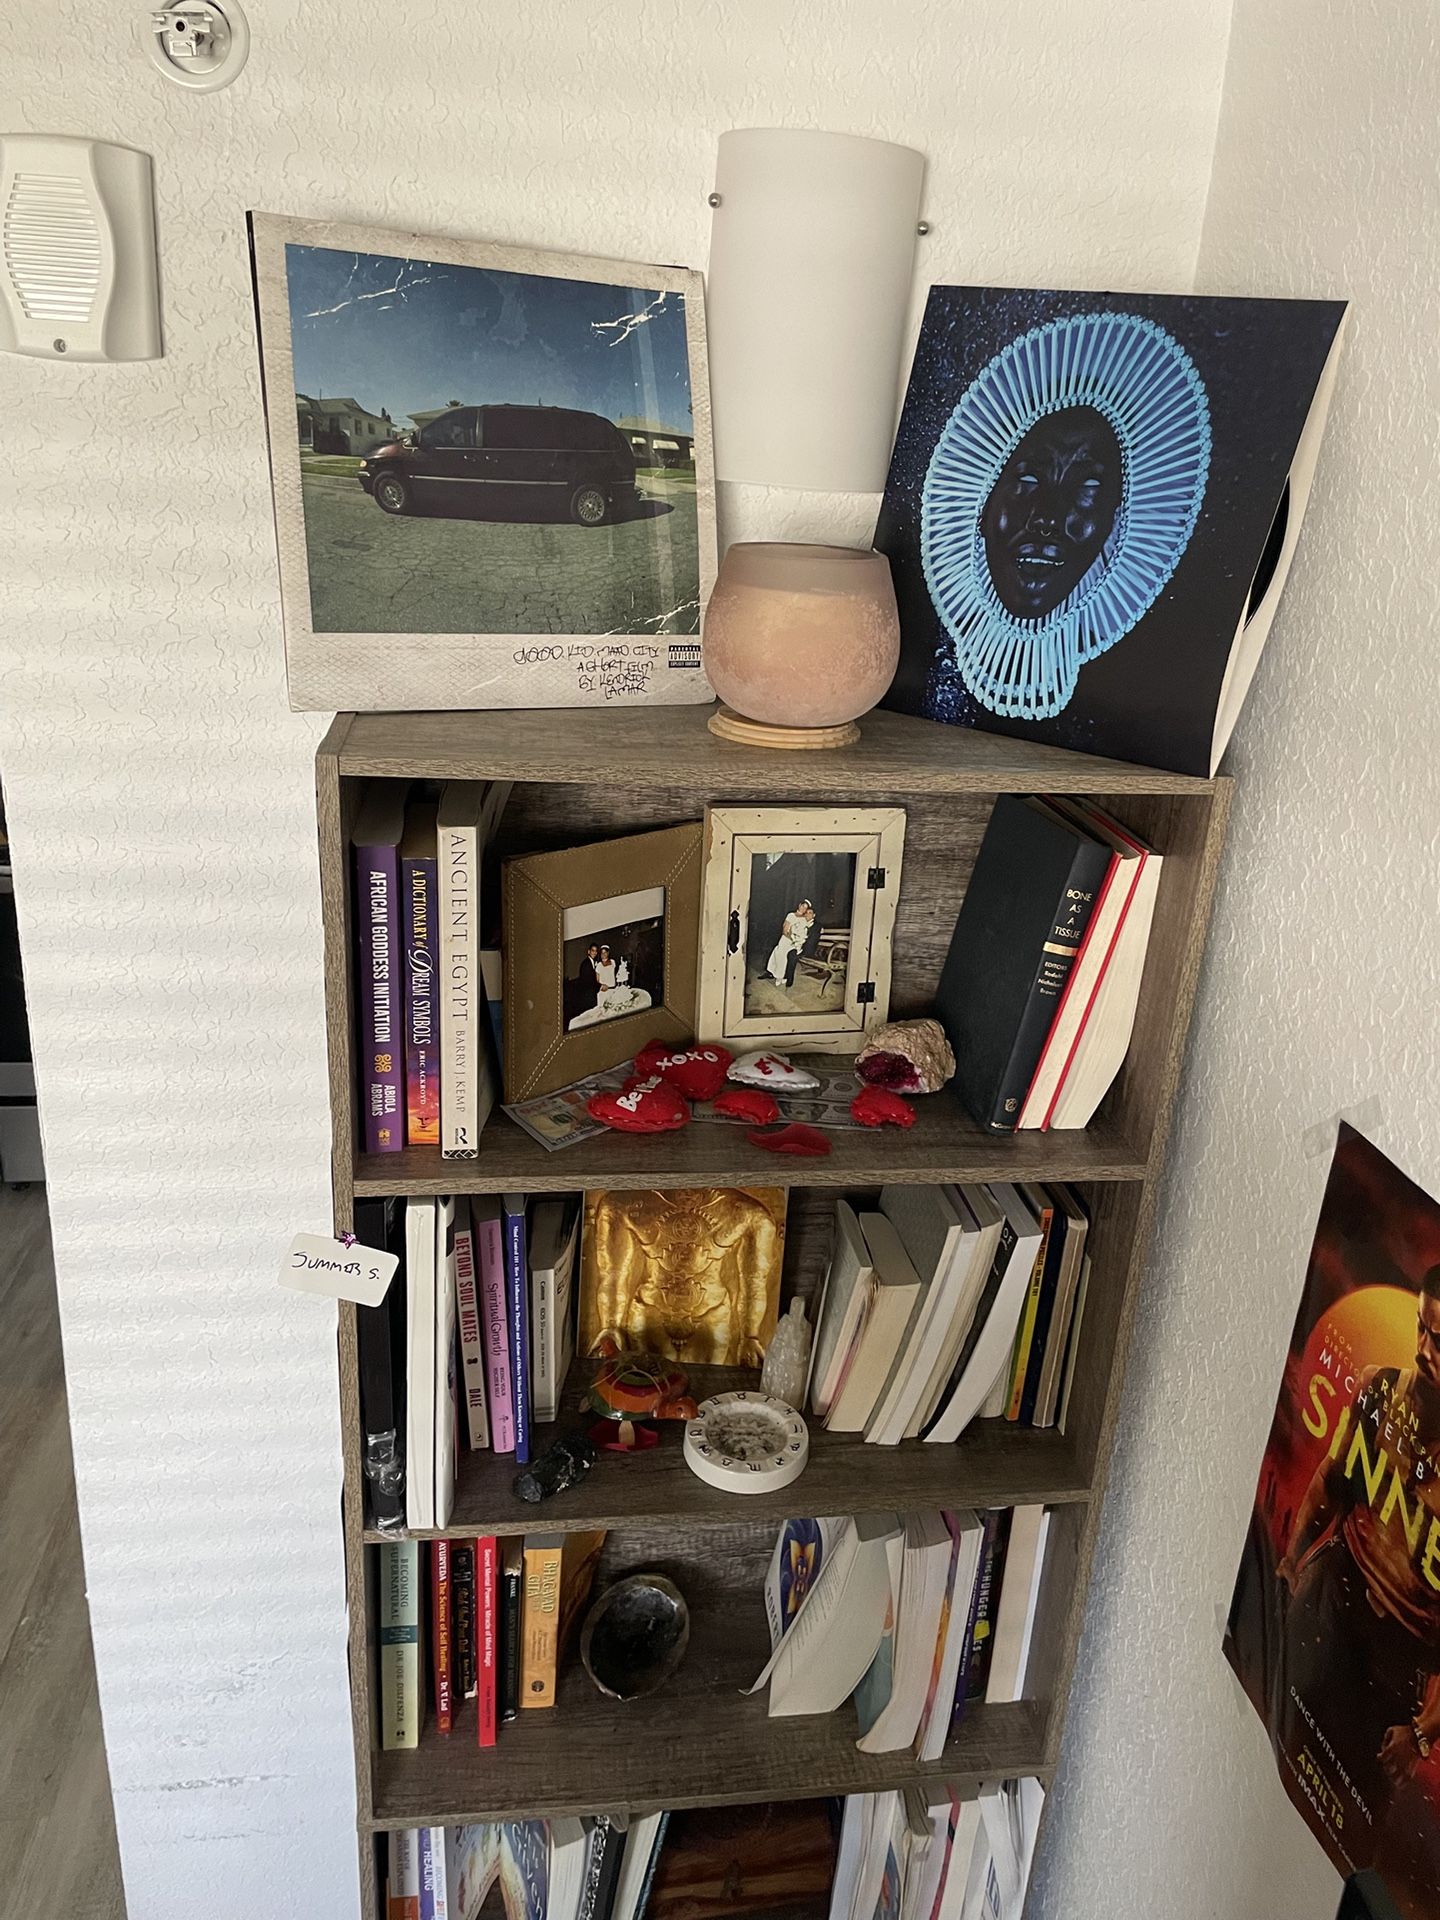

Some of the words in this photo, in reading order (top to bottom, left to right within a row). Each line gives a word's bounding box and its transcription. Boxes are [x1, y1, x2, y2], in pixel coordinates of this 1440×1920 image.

[605, 681, 648, 699] LAMAR
[412, 869, 426, 877] A
[450, 834, 468, 942] ANCIENT
[370, 871, 388, 923] AFRICAN
[412, 879, 428, 940] DICTIONARY
[1066, 888, 1093, 902] BONE
[1069, 904, 1083, 914] AS
[1054, 926, 1081, 939] TISSUE
[1067, 917, 1075, 926] A
[371, 926, 390, 980] GODDESS
[451, 954, 468, 1021] EGYPT
[373, 982, 391, 1043] INITIATION
[412, 1000, 431, 1045] SYMBOLS
[455, 1030, 465, 1070] BARRY
[371, 1083, 384, 1117] ABRAMS
[384, 1084, 397, 1114] ABIOLA
[419, 1070, 427, 1105] ACKROYD
[455, 1081, 466, 1113] KEMP
[291, 1251, 362, 1276] SUMMER
[456, 1237, 472, 1278] BEYOND
[460, 1281, 475, 1307] SOUL
[461, 1310, 478, 1344] MATES
[469, 1388, 482, 1408] DALE
[1319, 1348, 1403, 1455] MICHAEL
[1381, 1378, 1419, 1431] RYAN
[1383, 1400, 1417, 1446] BLACK
[438, 1541, 447, 1581] AYURVEDA
[484, 1548, 492, 1567] Secret
[985, 1561, 993, 1572] THE
[390, 1545, 400, 1620] SUPERNATURAL
[400, 1558, 409, 1608] BECOMING
[439, 1582, 447, 1595] The
[484, 1567, 492, 1587] Mental
[527, 1574, 541, 1599] GITA
[541, 1560, 558, 1614] BHAGAVAD
[439, 1596, 447, 1622] Science
[977, 1575, 992, 1618] HUNGER
[440, 1623, 447, 1631] of
[485, 1636, 493, 1651] Mind
[396, 1665, 405, 1680] JOE
[484, 1651, 493, 1668] Magic
[396, 1682, 405, 1723] DISPENZA
[1290, 1686, 1315, 1730] DANCE
[1316, 1727, 1335, 1762] WITH
[1336, 1759, 1350, 1789] THE
[1350, 1786, 1373, 1826] DEVIL
[1297, 1753, 1328, 1807] APRIL
[1330, 1804, 1344, 1830] 18
[1298, 1773, 1326, 1824] IMAX
[423, 1851, 434, 1892] HEALING
